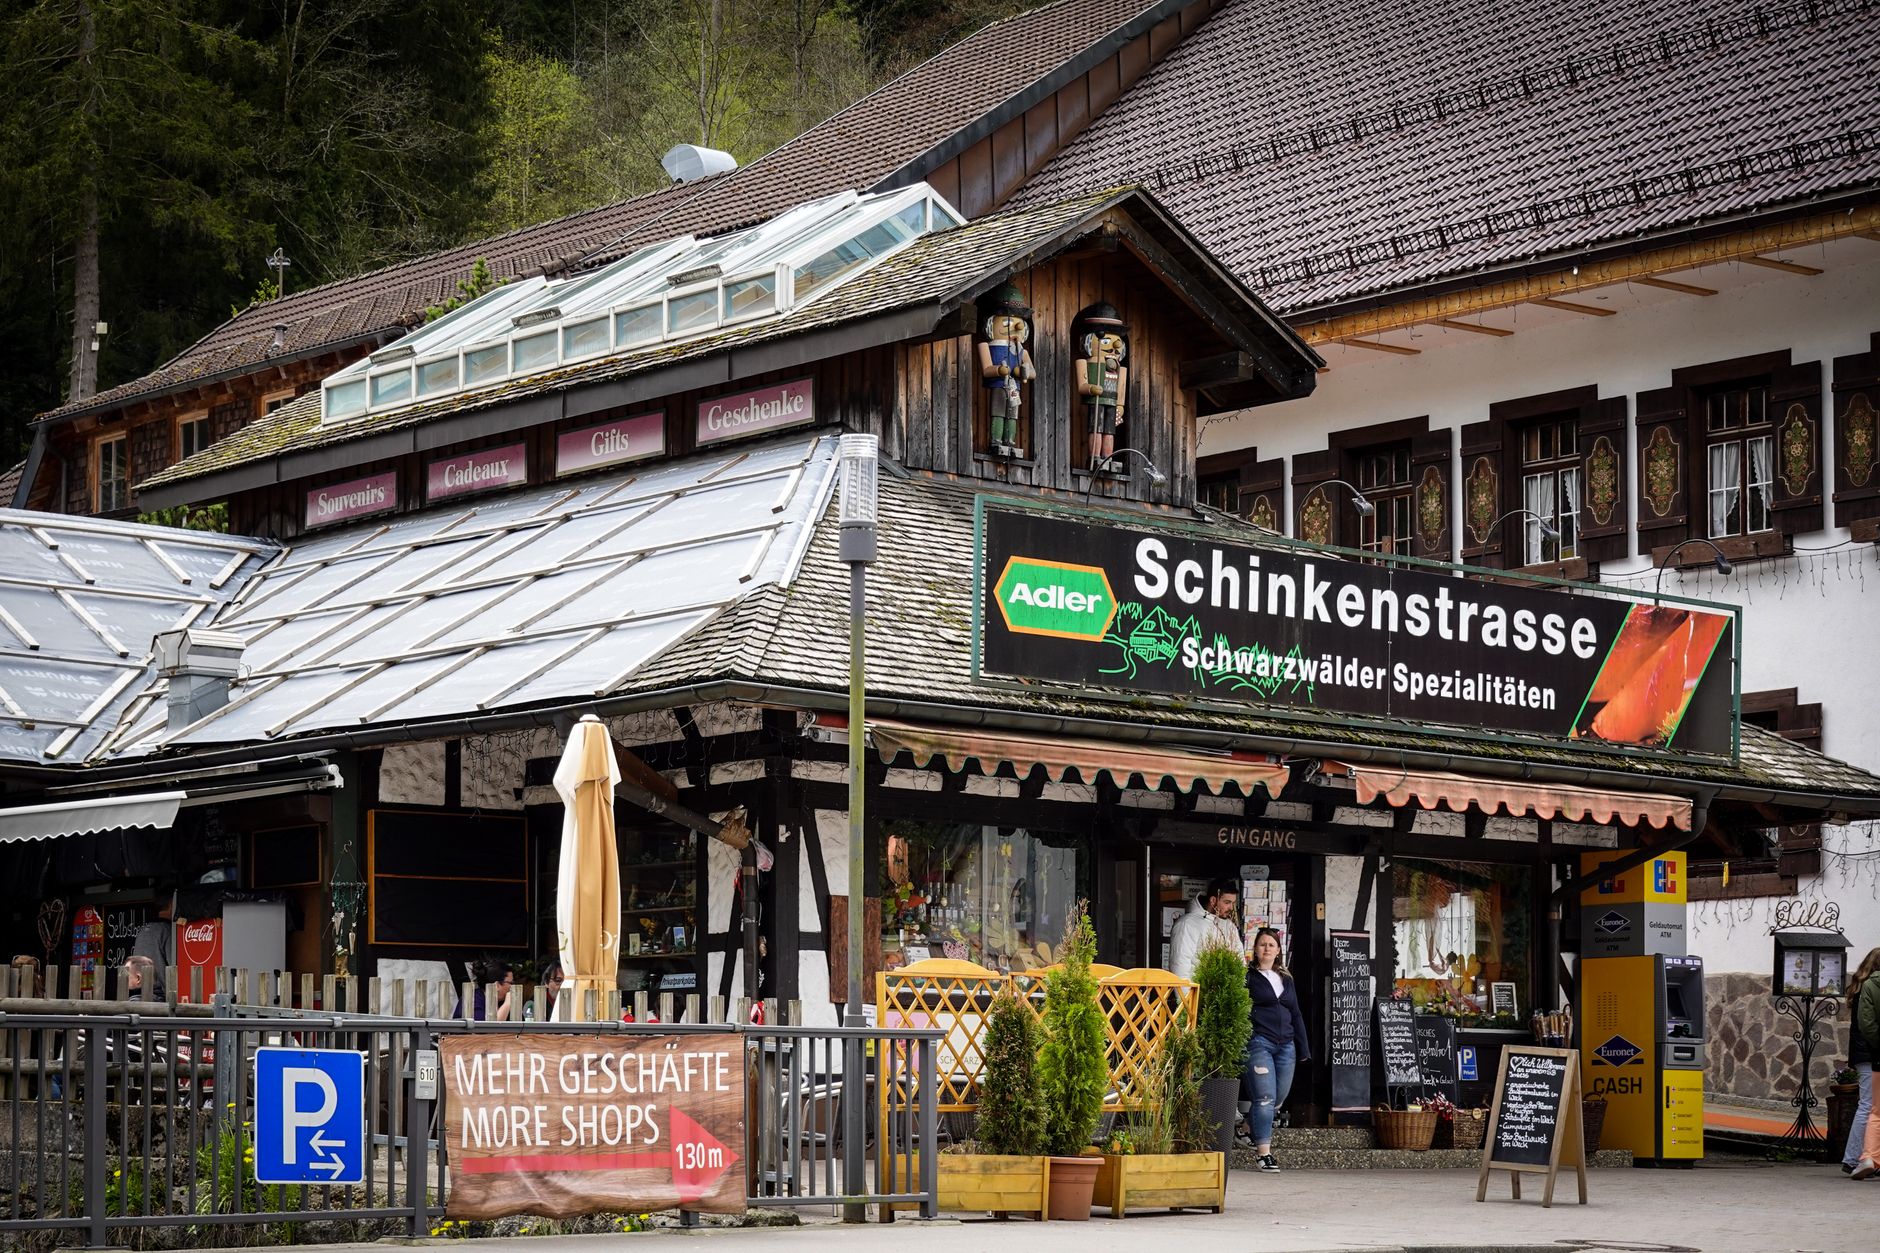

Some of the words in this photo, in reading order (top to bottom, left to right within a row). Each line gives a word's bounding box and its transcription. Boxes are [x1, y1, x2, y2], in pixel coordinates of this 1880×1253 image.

[707, 390, 803, 431] Geschenke
[591, 428, 629, 457] Gifts
[444, 458, 509, 488] Cadeaux
[317, 483, 385, 516] Souvenirs
[1009, 582, 1102, 614] Adler
[1133, 537, 1597, 660] Schinkenstrasse
[1181, 636, 1387, 691] Schwarzwälder
[1392, 662, 1556, 711] Spezialitäten
[1218, 827, 1297, 849] EINGANG
[1601, 918, 1624, 927] Euronet
[1649, 921, 1683, 930] Geldautomat
[1778, 900, 1837, 929] Lilie
[1333, 1011, 1341, 1022] Do
[1333, 1025, 1339, 1037] Fr
[1332, 1038, 1341, 1049] Sa
[1601, 1046, 1634, 1057] Euronet
[940, 1056, 979, 1065] SCHARZ
[1333, 1051, 1342, 1065] So
[1463, 1049, 1473, 1064] P
[420, 1068, 434, 1080] 610
[454, 1052, 550, 1096] MEHR
[558, 1043, 730, 1095] GESCHÄFTE
[1593, 1077, 1642, 1094] CASH
[282, 1067, 338, 1164] P
[461, 1104, 551, 1148] MORE
[560, 1103, 661, 1147] SHOPS
[1502, 1132, 1513, 1141] Bio
[675, 1143, 706, 1170] 130
[708, 1148, 723, 1168] m
